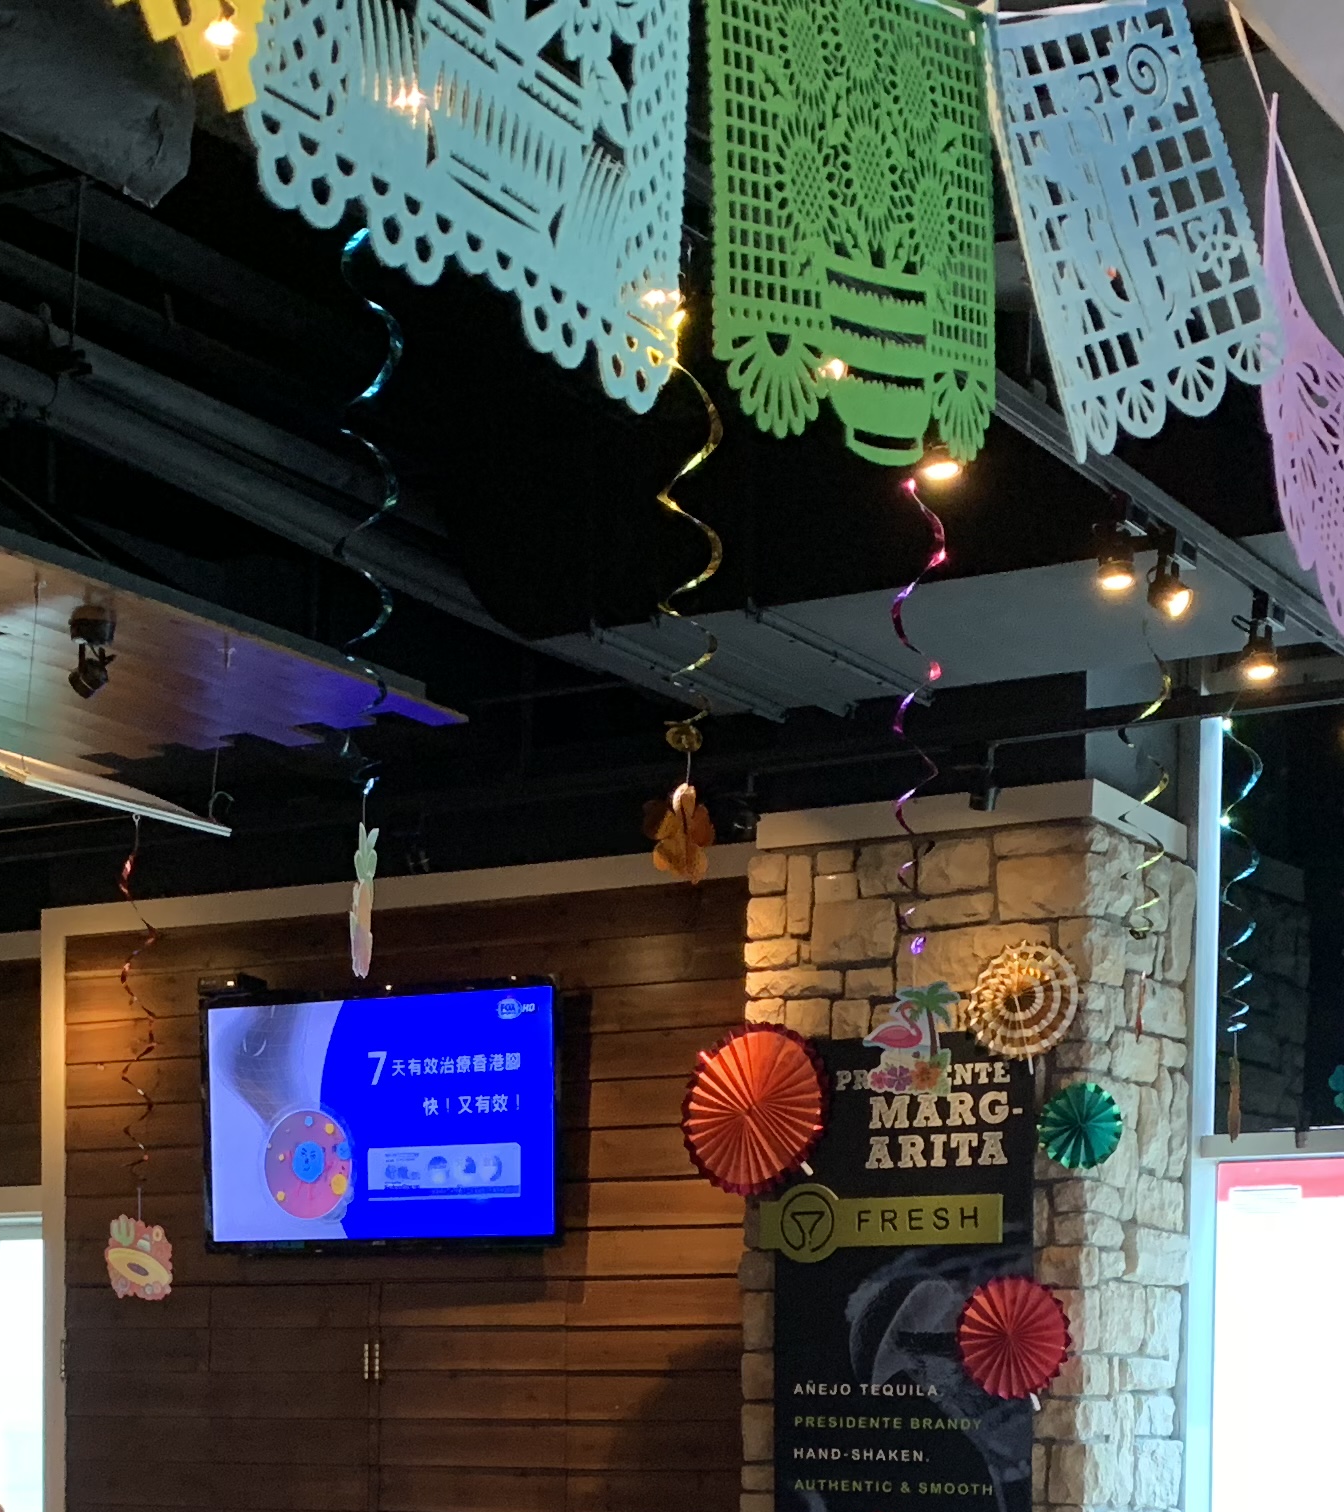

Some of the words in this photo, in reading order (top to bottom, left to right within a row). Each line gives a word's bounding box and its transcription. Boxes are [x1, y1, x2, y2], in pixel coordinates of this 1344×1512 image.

[869, 1091, 1023, 1129] MARG-
[865, 1131, 1008, 1169] ARITA
[856, 1206, 979, 1233] FRESH
[793, 1380, 852, 1396] AÑEJO
[794, 1416, 903, 1429] PRESIDENTE
[910, 1417, 982, 1431] BRANDY
[793, 1448, 930, 1463] HAND-SHAKEN.
[794, 1479, 893, 1493] AUTHENTIC
[900, 1481, 911, 1494] &
[918, 1482, 993, 1496] SMOOTH
